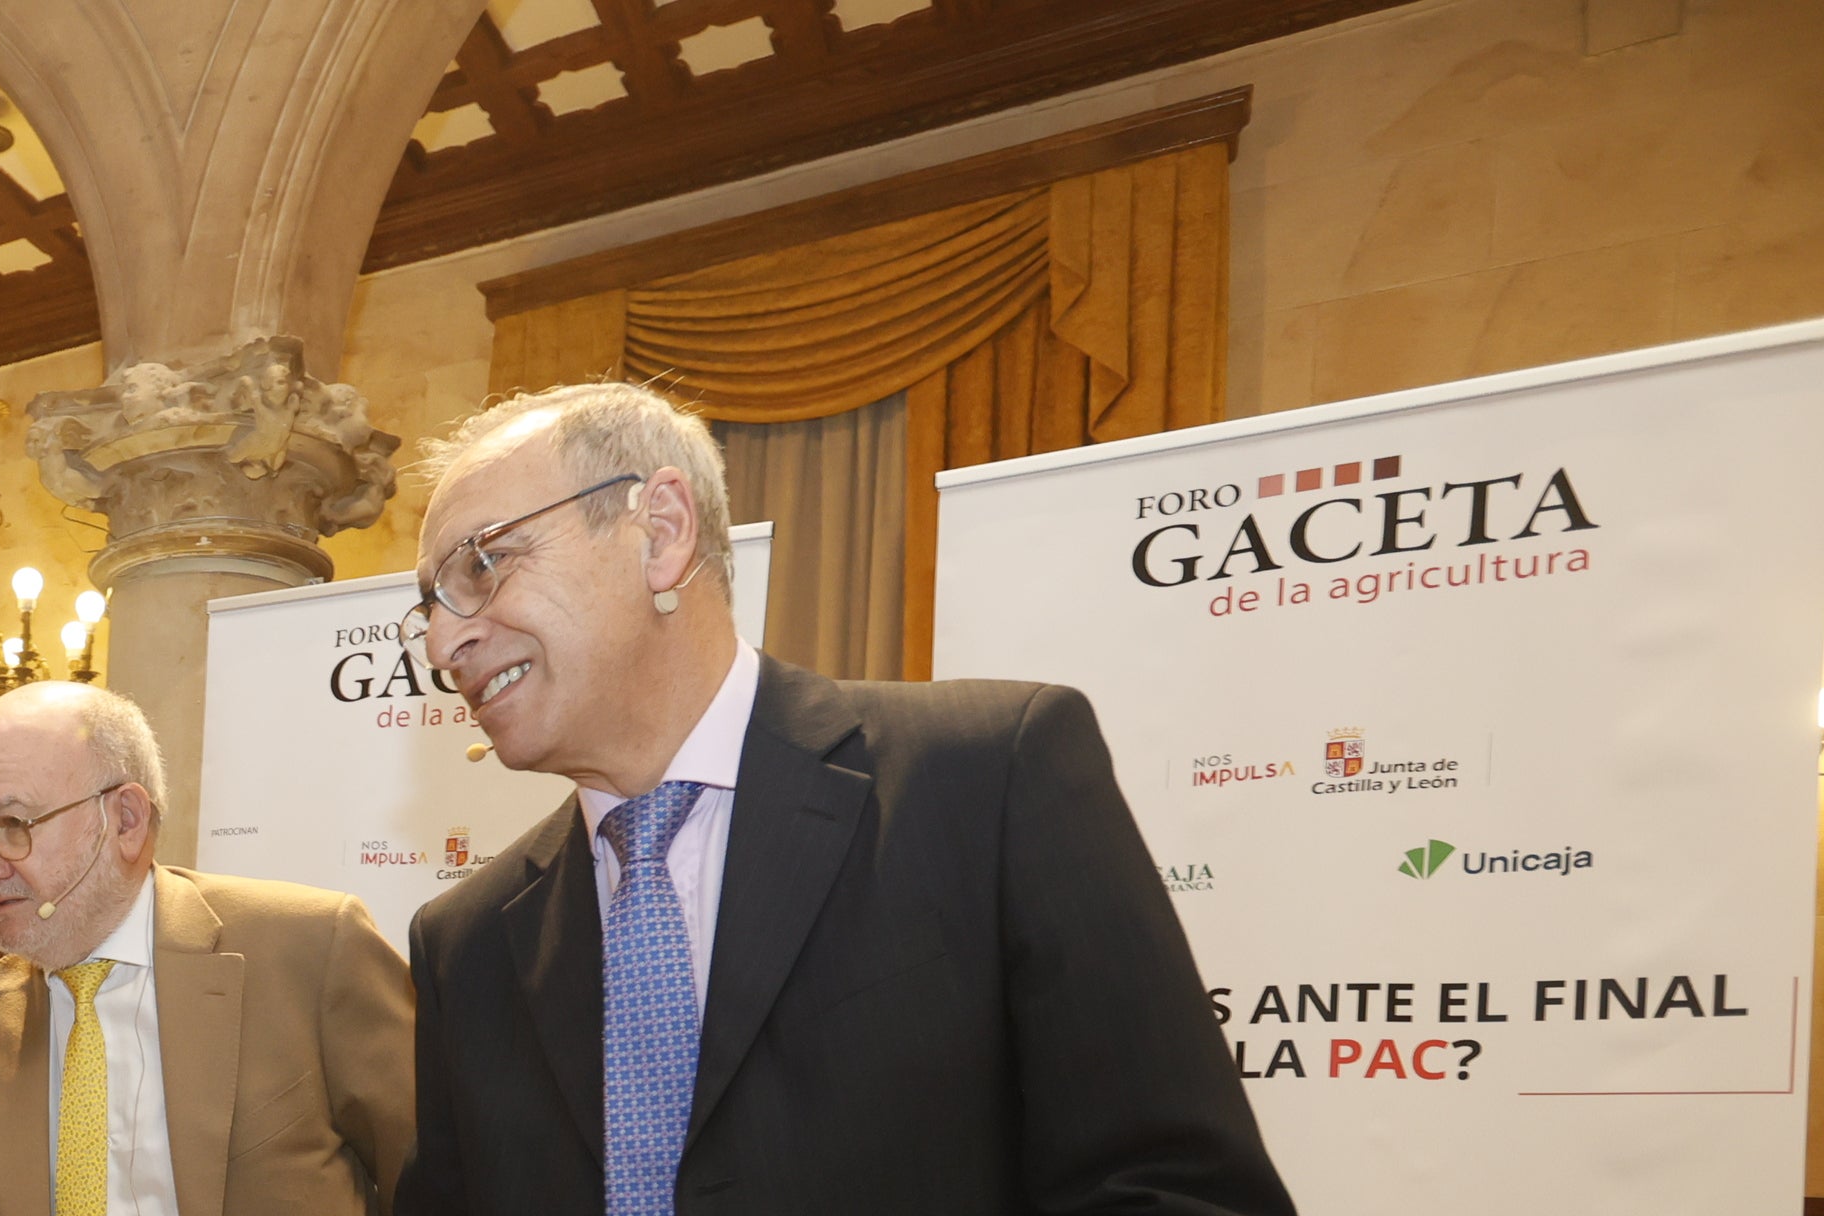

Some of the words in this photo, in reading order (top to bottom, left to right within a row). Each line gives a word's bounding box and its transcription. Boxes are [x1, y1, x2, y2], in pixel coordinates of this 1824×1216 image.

[1135, 483, 1242, 520] FORO
[1132, 466, 1602, 588] GACETA
[1209, 586, 1261, 617] de
[1277, 577, 1312, 607] la
[1328, 548, 1591, 605] agricultura
[334, 621, 402, 648] FORO
[330, 651, 462, 702] GAC
[377, 704, 411, 729] de
[421, 702, 443, 726] la
[1192, 761, 1296, 788] IMPULSA
[1193, 753, 1233, 769] NOS
[1367, 761, 1426, 775] Junta
[1432, 758, 1459, 772] de
[1311, 778, 1383, 795] Castilla
[1387, 780, 1402, 795] y
[1407, 775, 1459, 790] León
[361, 840, 389, 850] NOS
[360, 851, 429, 867] IMPULSA
[470, 854, 495, 866] Jun
[1462, 846, 1594, 876] Unicaja
[1158, 863, 1215, 883] AJA
[1249, 982, 1416, 1025] ANTE
[1438, 982, 1509, 1024] EL
[1533, 973, 1750, 1022] FINAL
[1235, 1039, 1307, 1079] LA
[1328, 1038, 1483, 1081] PAC?
